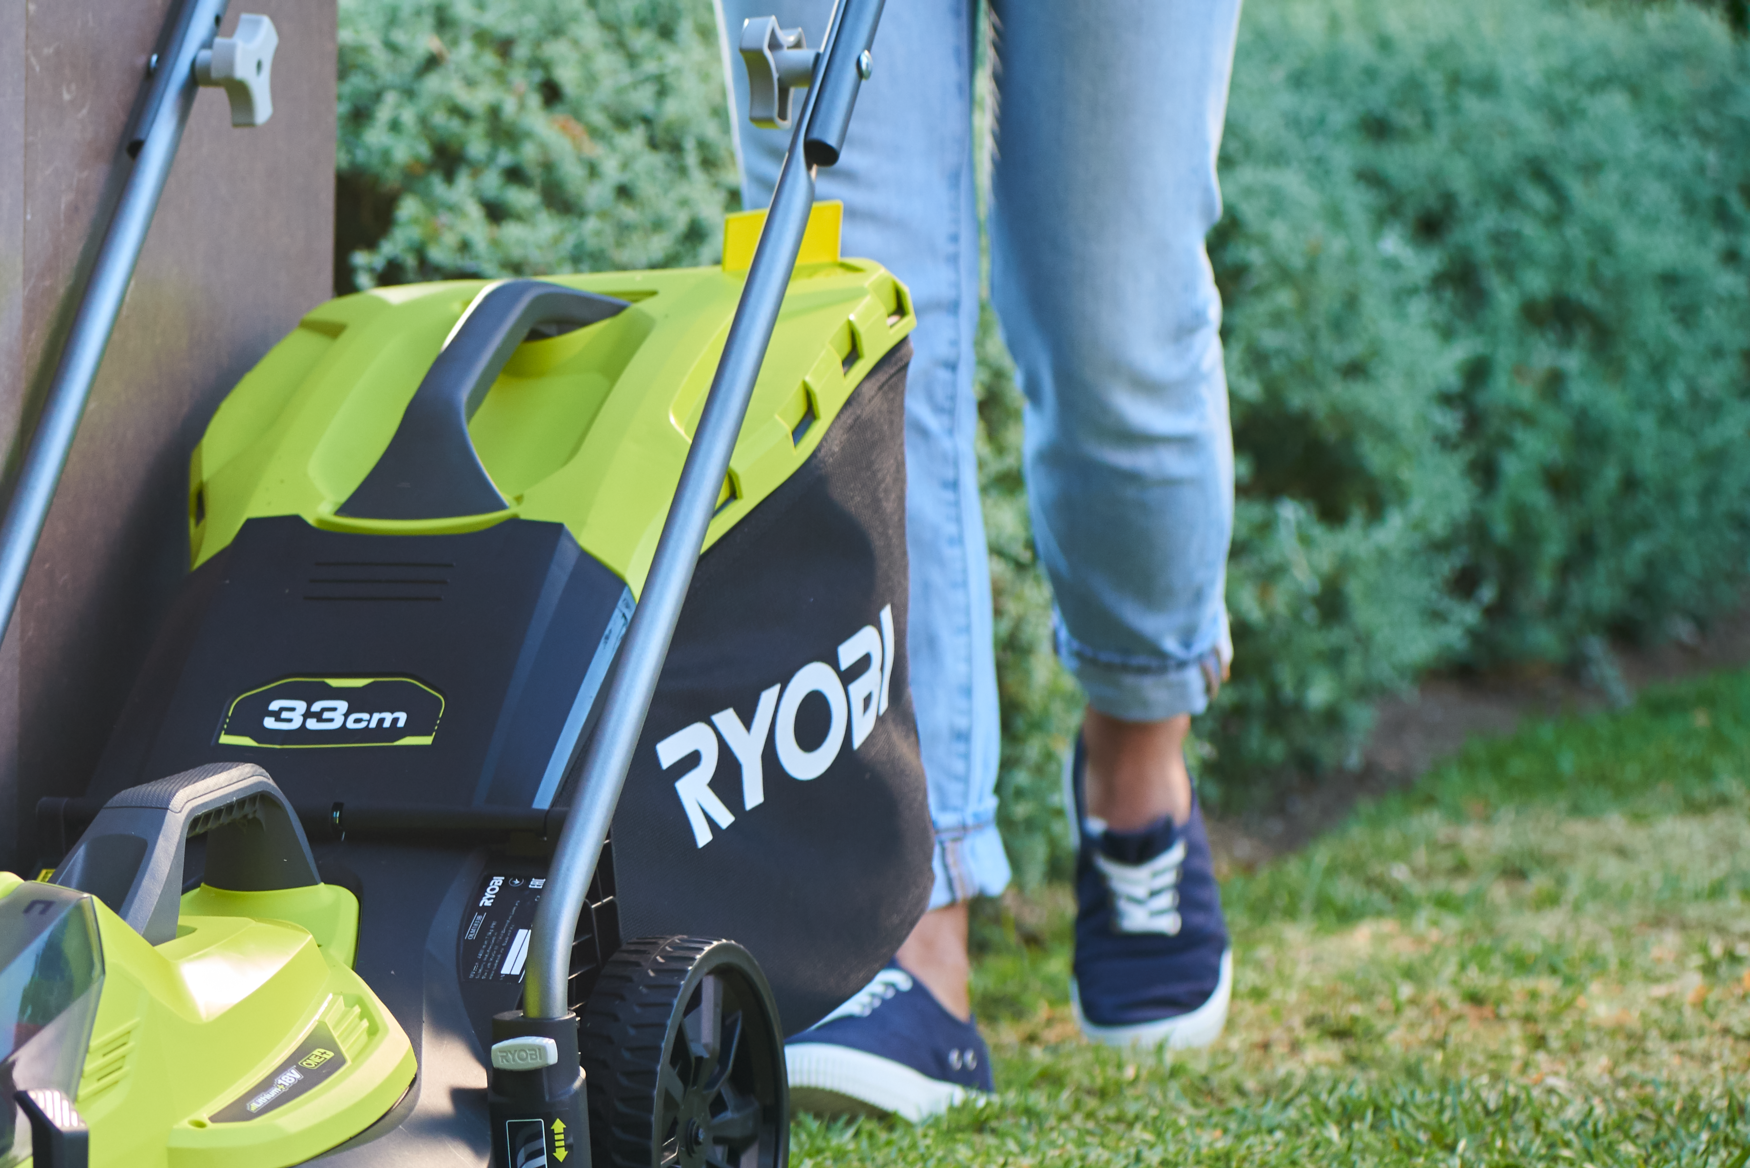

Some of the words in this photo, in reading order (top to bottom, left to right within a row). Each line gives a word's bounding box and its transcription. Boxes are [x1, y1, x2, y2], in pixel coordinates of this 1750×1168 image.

[262, 698, 408, 731] 33cm
[655, 603, 895, 849] RYOBI
[479, 876, 505, 907] RYOBI
[497, 1047, 543, 1065] RYOBI
